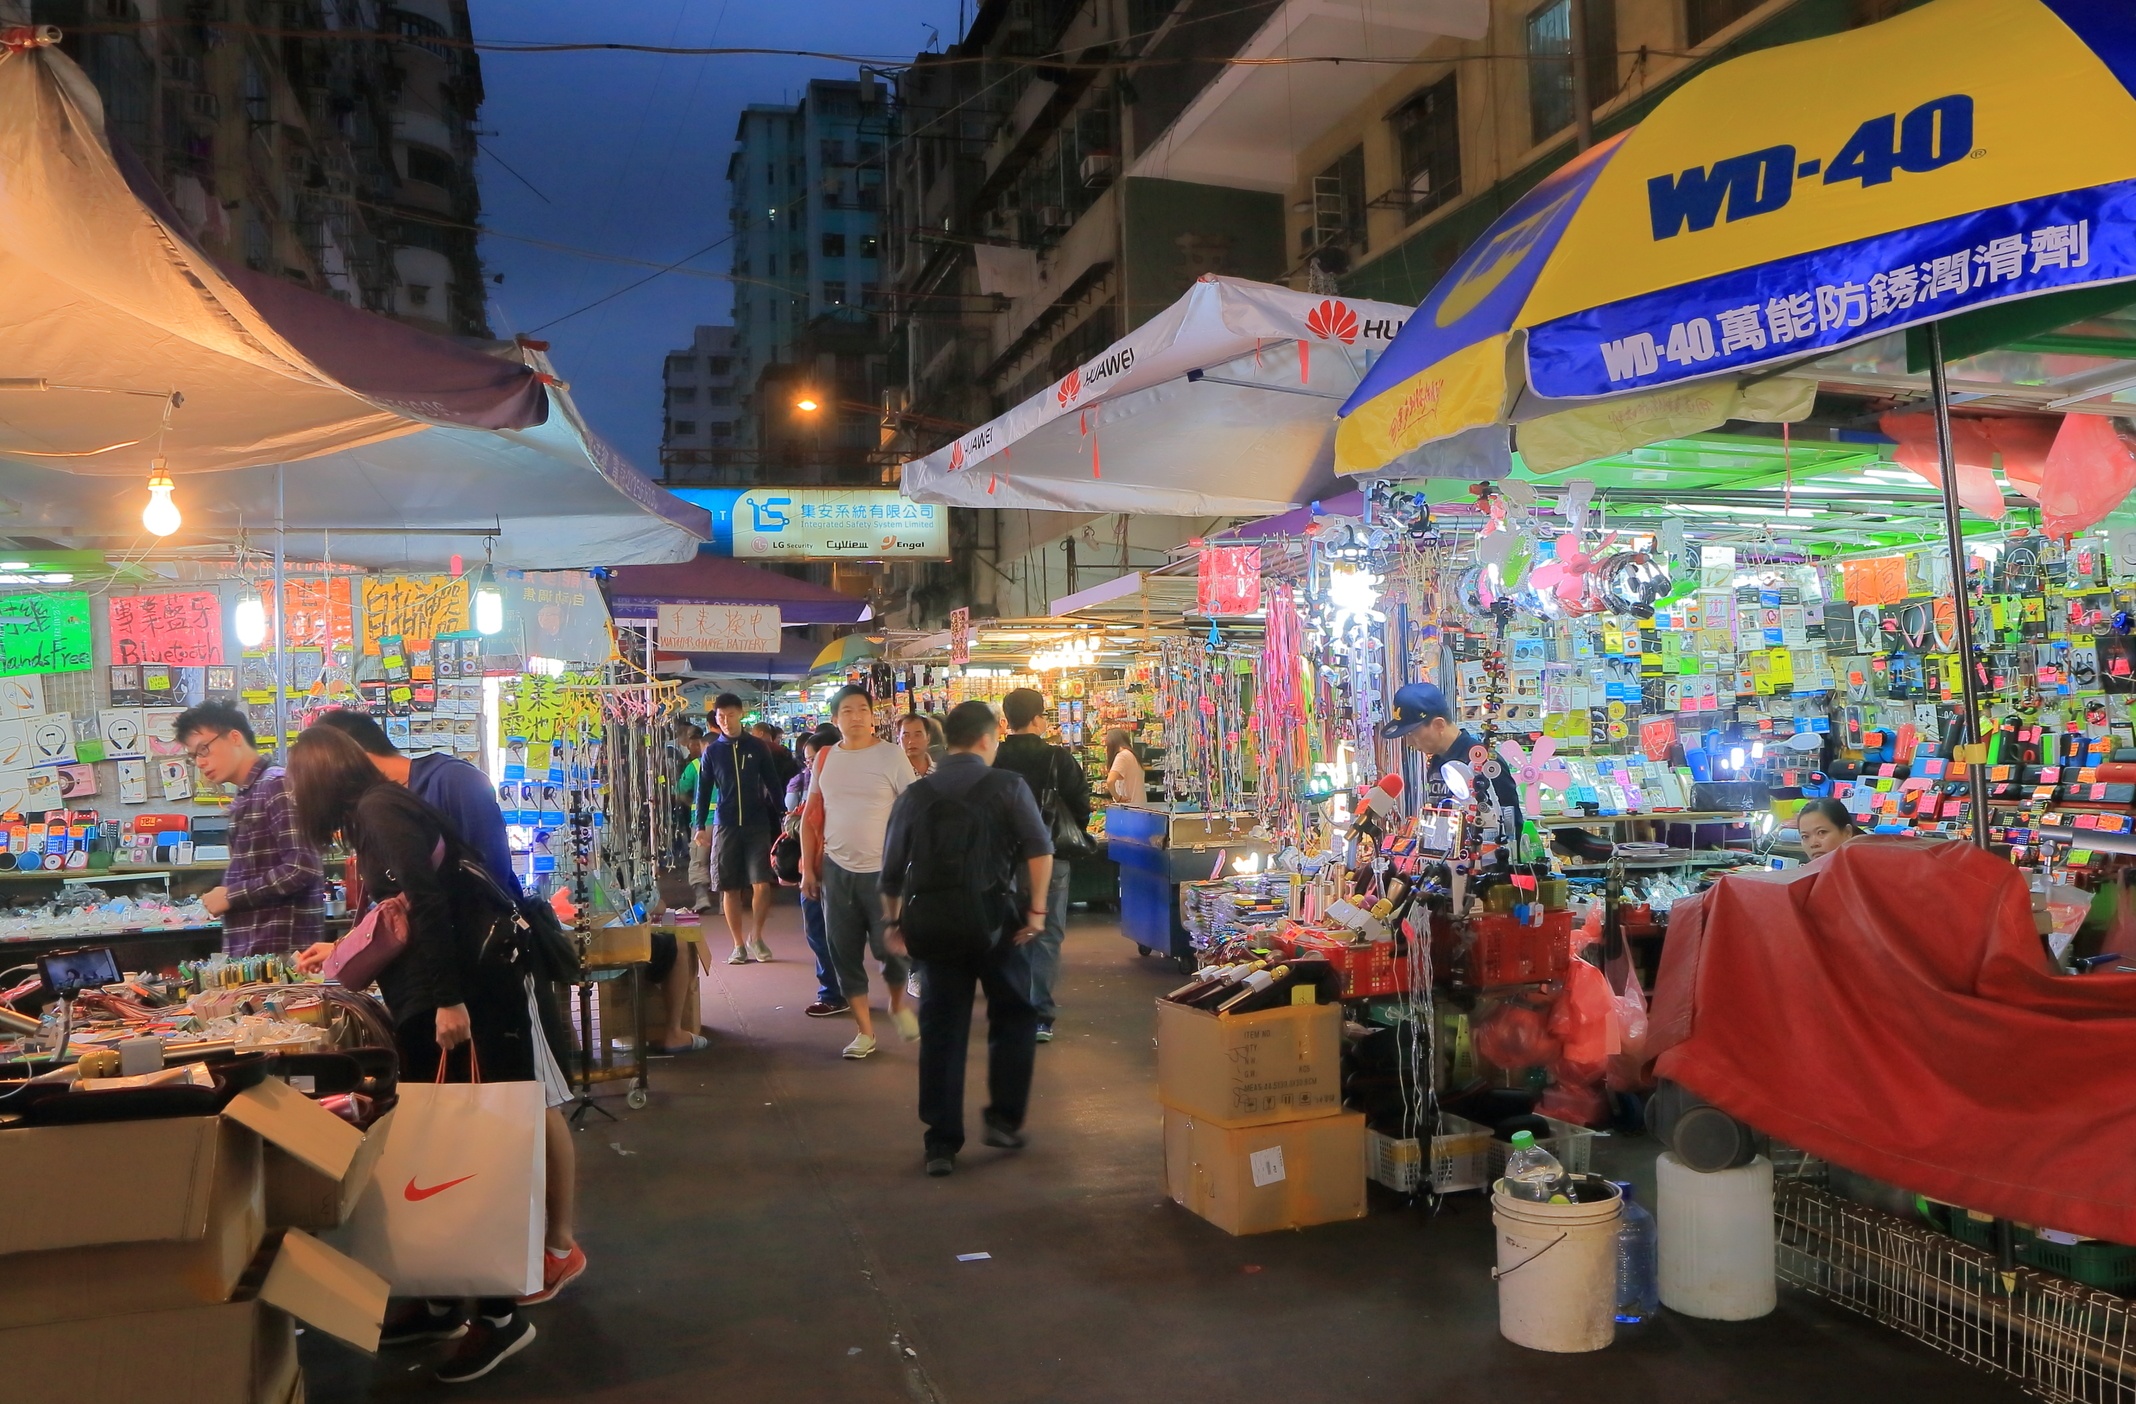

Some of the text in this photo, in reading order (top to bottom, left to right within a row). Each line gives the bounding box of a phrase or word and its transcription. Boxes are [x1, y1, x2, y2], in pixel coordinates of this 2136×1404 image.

[1648, 94, 1975, 242] WD-40
[1083, 347, 1134, 388] HUAWEI
[963, 426, 994, 456] HUAWEI
[800, 503, 934, 519] 集安系統有限公司
[800, 520, 934, 531] Integrated Safety System Limited
[772, 541, 814, 550] LG Security
[826, 539, 869, 551] CyView
[119, 632, 221, 665] Bluetooth
